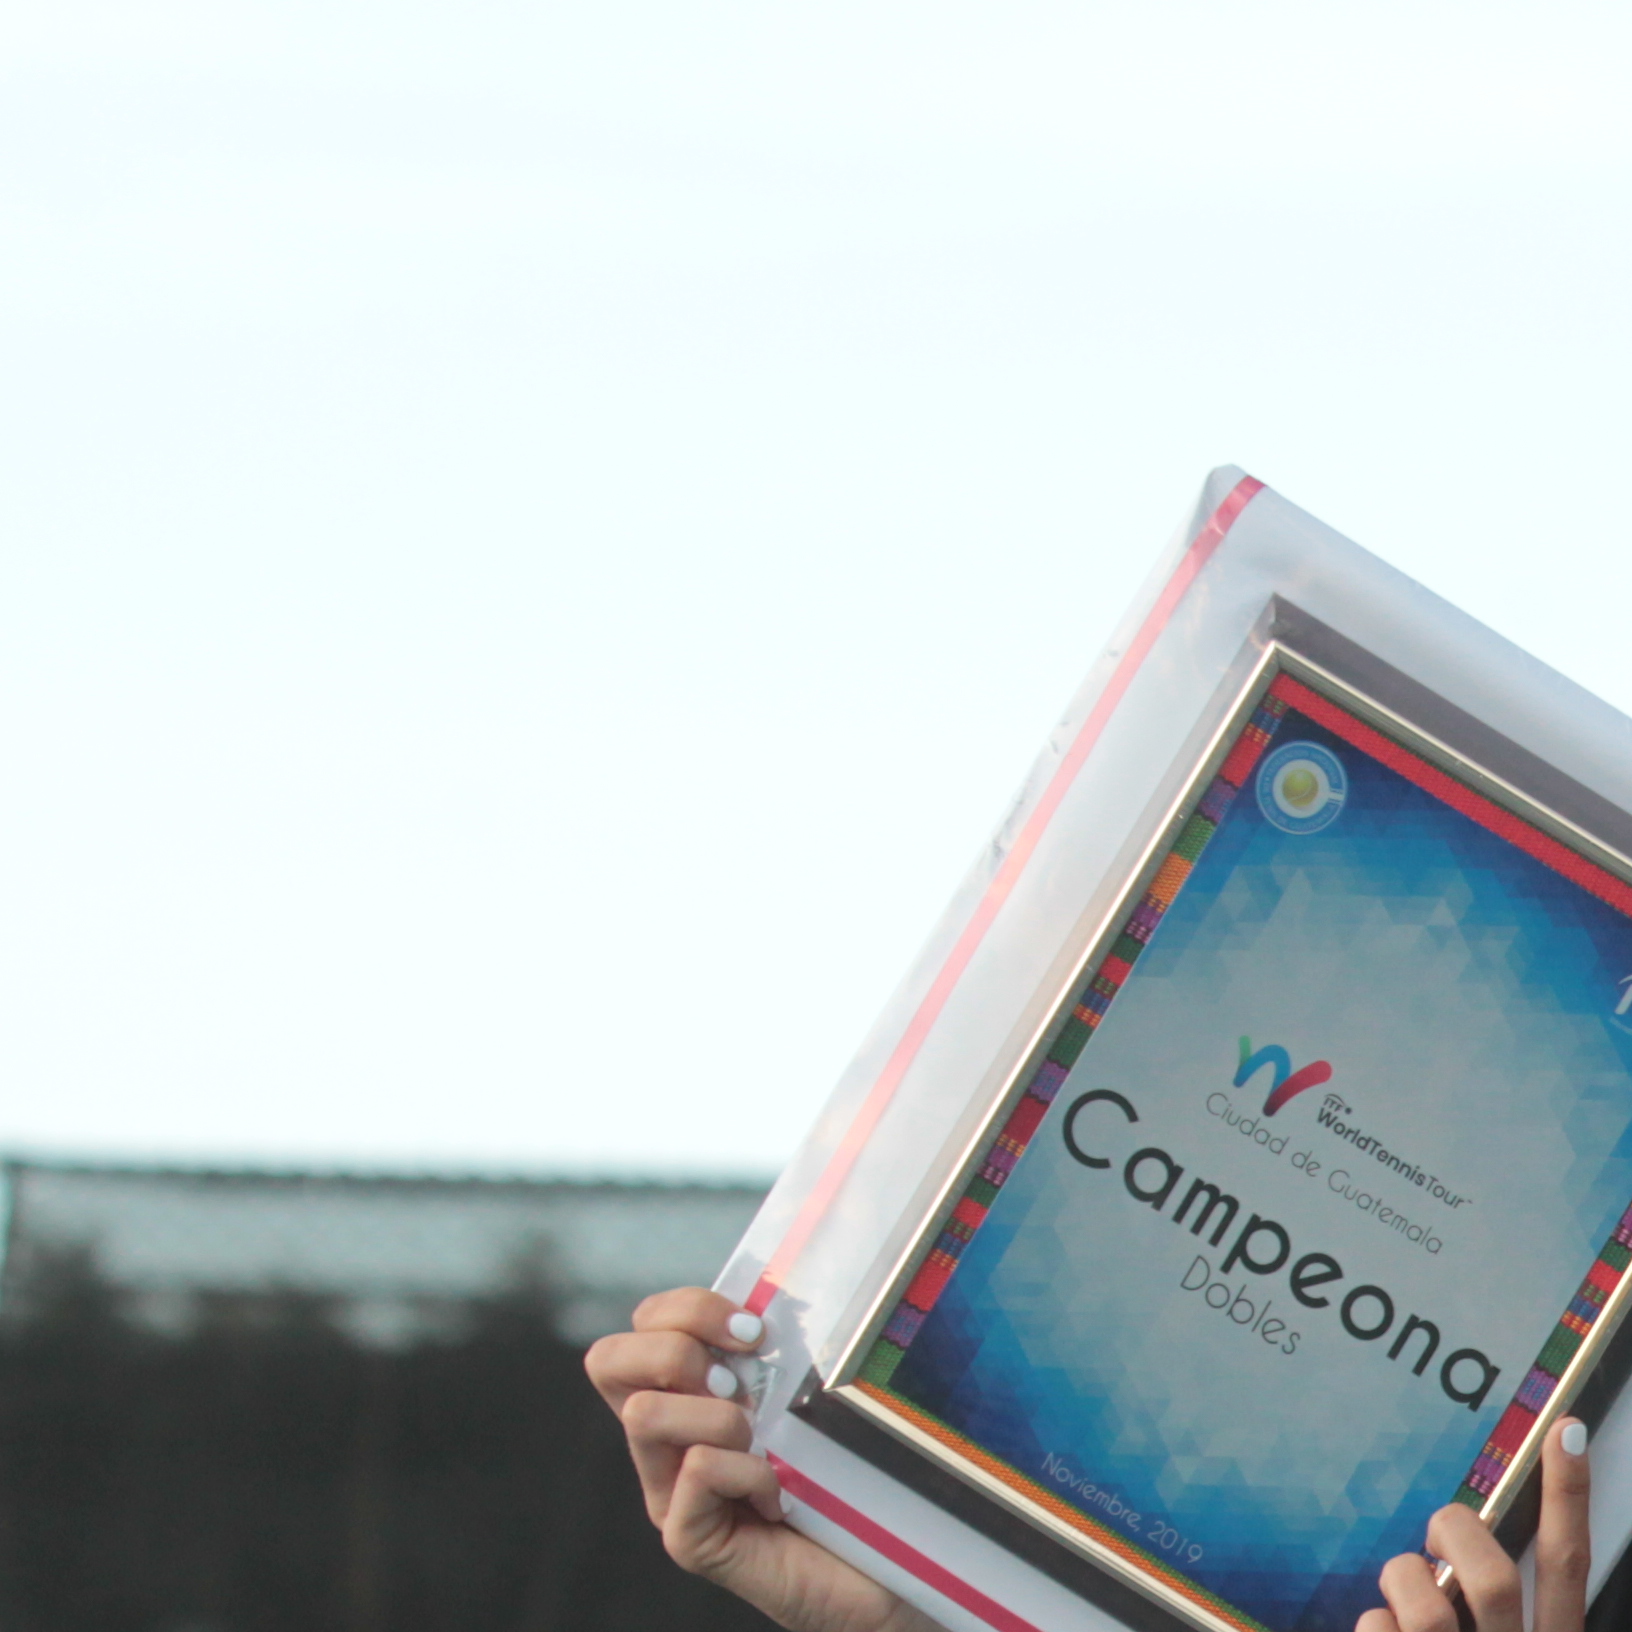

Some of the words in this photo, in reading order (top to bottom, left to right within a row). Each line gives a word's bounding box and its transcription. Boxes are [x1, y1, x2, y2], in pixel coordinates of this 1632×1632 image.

[1206, 1092, 1290, 1155] Ciudad
[1291, 1151, 1321, 1177] de
[1328, 1170, 1443, 1254] Guatemala
[1062, 1089, 1501, 1413] Campeona
[1180, 1255, 1301, 1355] Dobles
[1041, 1452, 1141, 1532] Noviembre,
[1147, 1520, 1204, 1564] 2019
